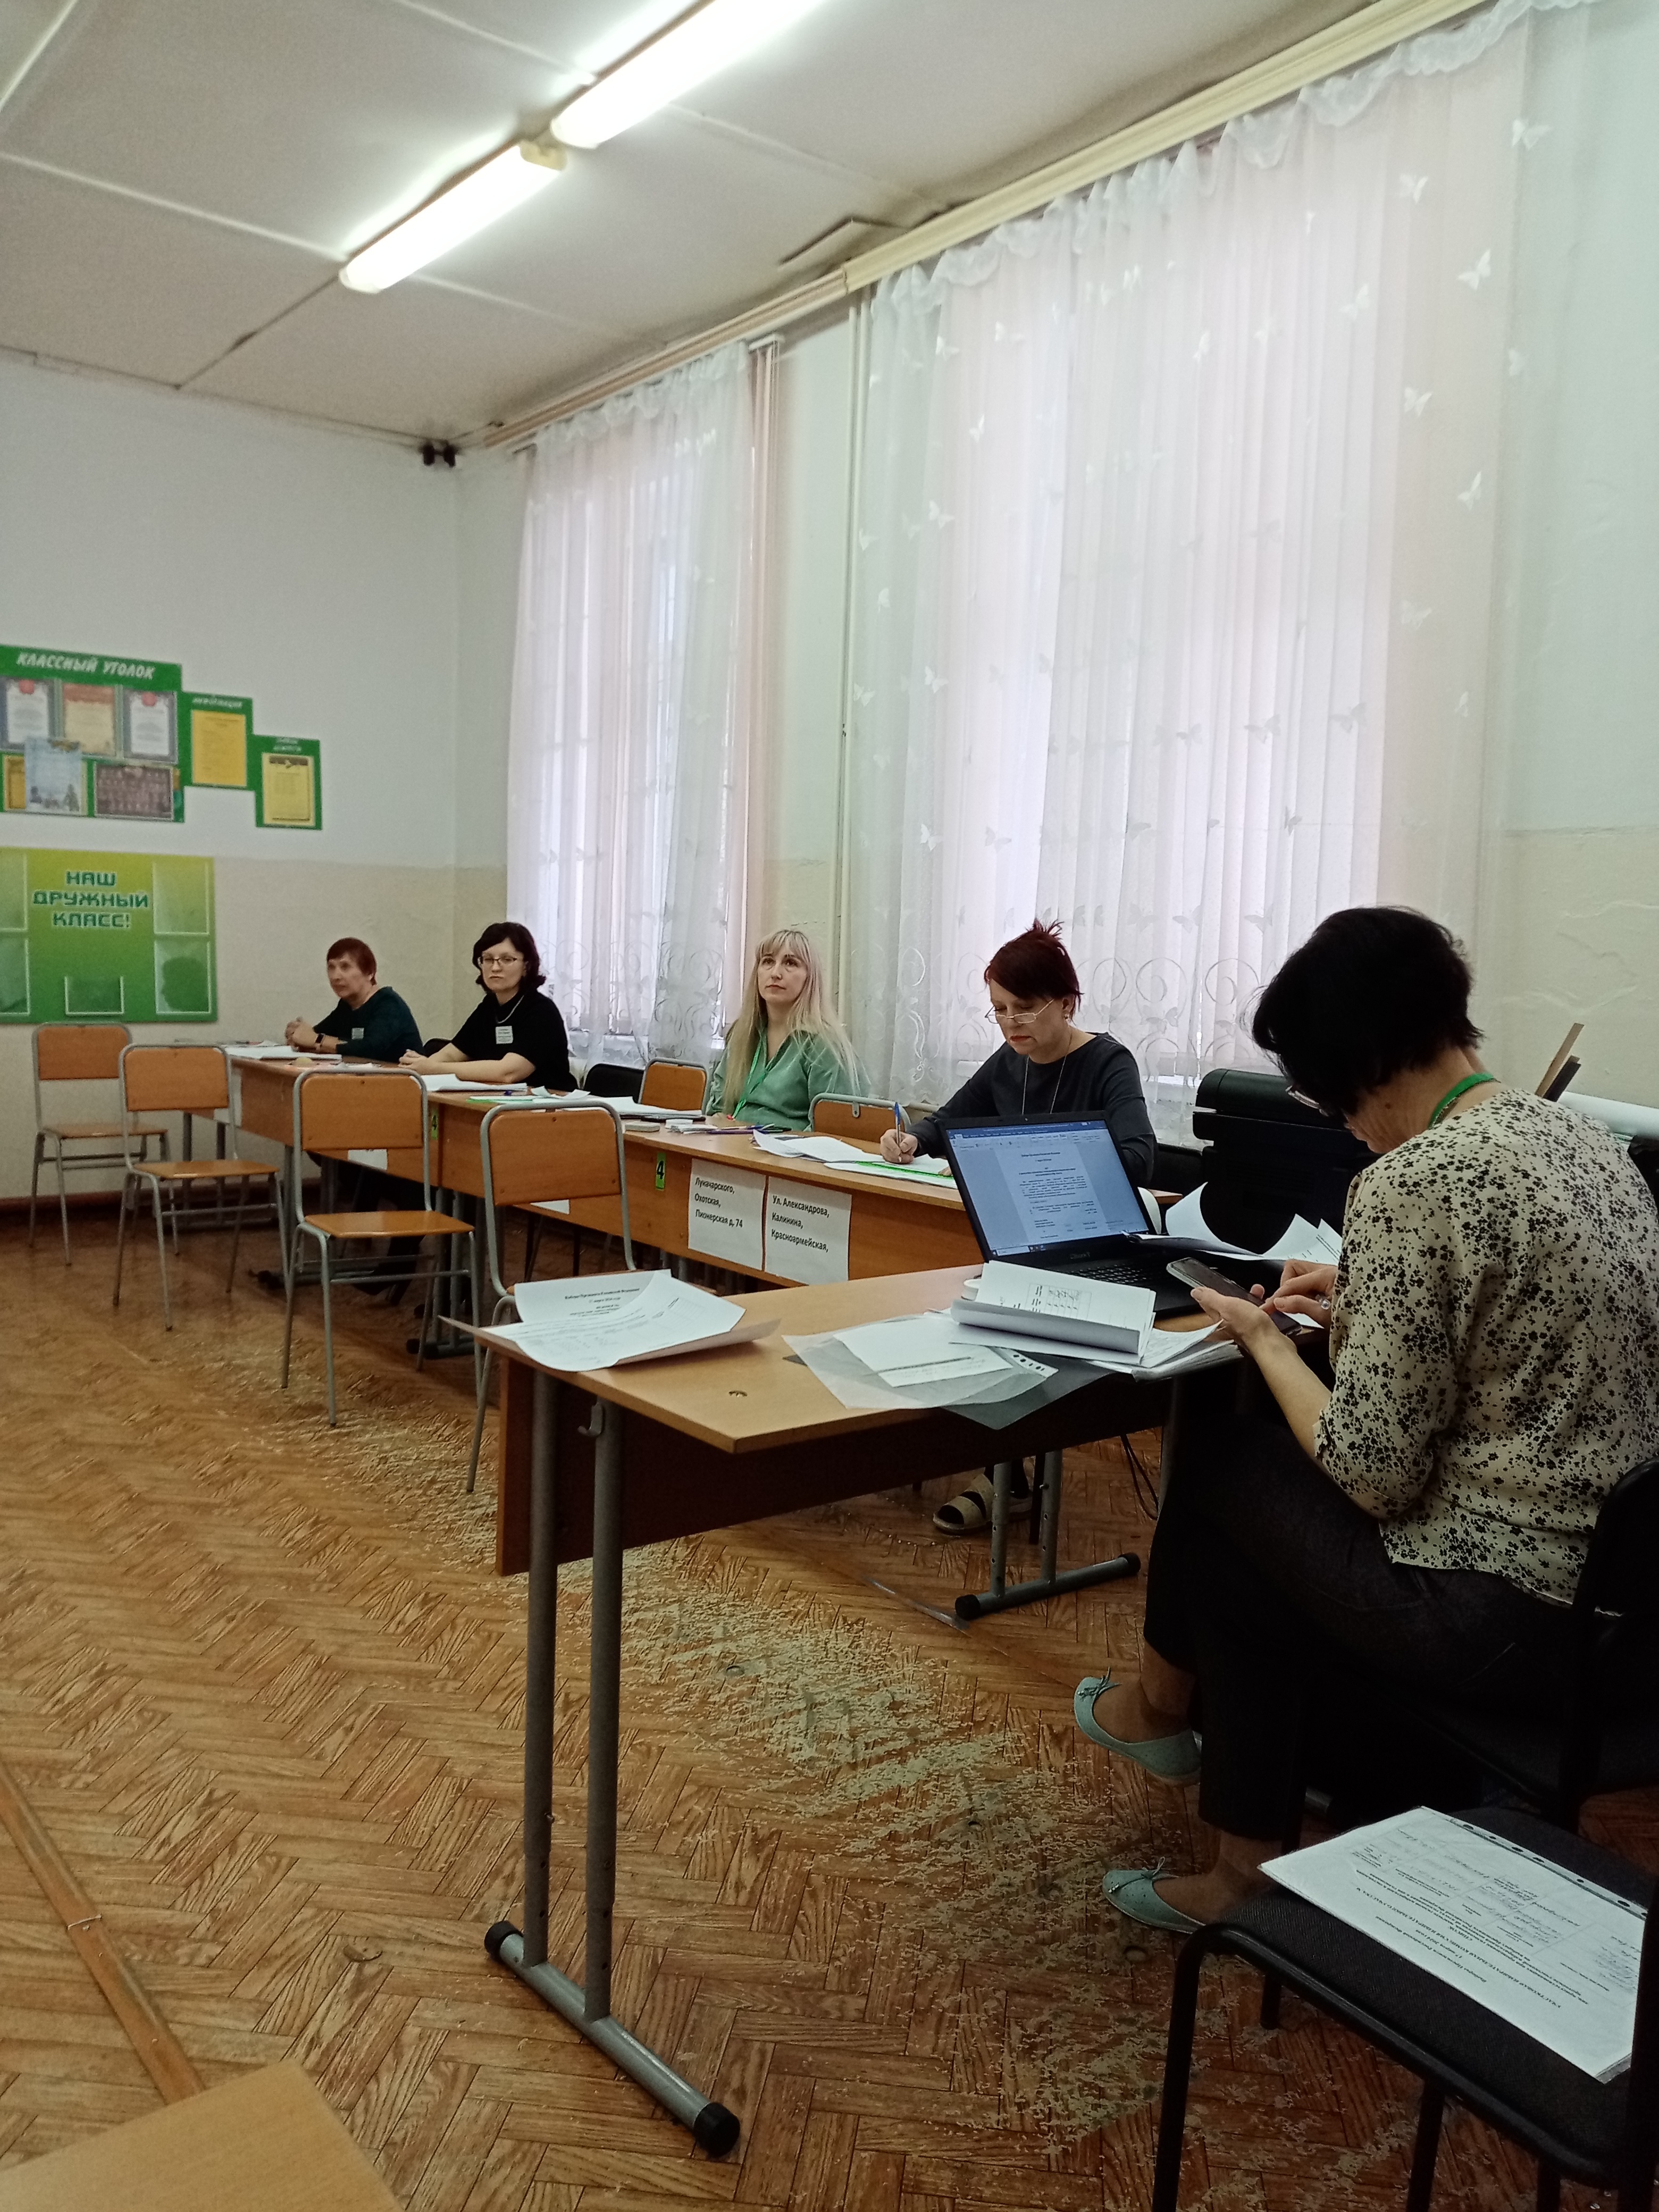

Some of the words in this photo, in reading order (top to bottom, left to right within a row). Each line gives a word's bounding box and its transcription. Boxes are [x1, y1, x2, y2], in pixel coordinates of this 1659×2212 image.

[16, 652, 98, 673] КЛАССНЫЙ
[103, 661, 156, 680] УГОЛОК
[66, 870, 116, 886] НАШ
[33, 891, 148, 907] ДРУЖНЫЙ
[53, 912, 130, 928] КЛАСС!
[657, 1160, 665, 1180] 4
[694, 1193, 721, 1208] Охотская,
[773, 1195, 782, 1205] Ул.
[783, 1197, 830, 1218] Александрова,
[695, 1209, 728, 1224] Пионерская
[735, 1218, 743, 1228] 74
[772, 1212, 803, 1229] Калинина,
[772, 1228, 828, 1253] Красноармейская,
